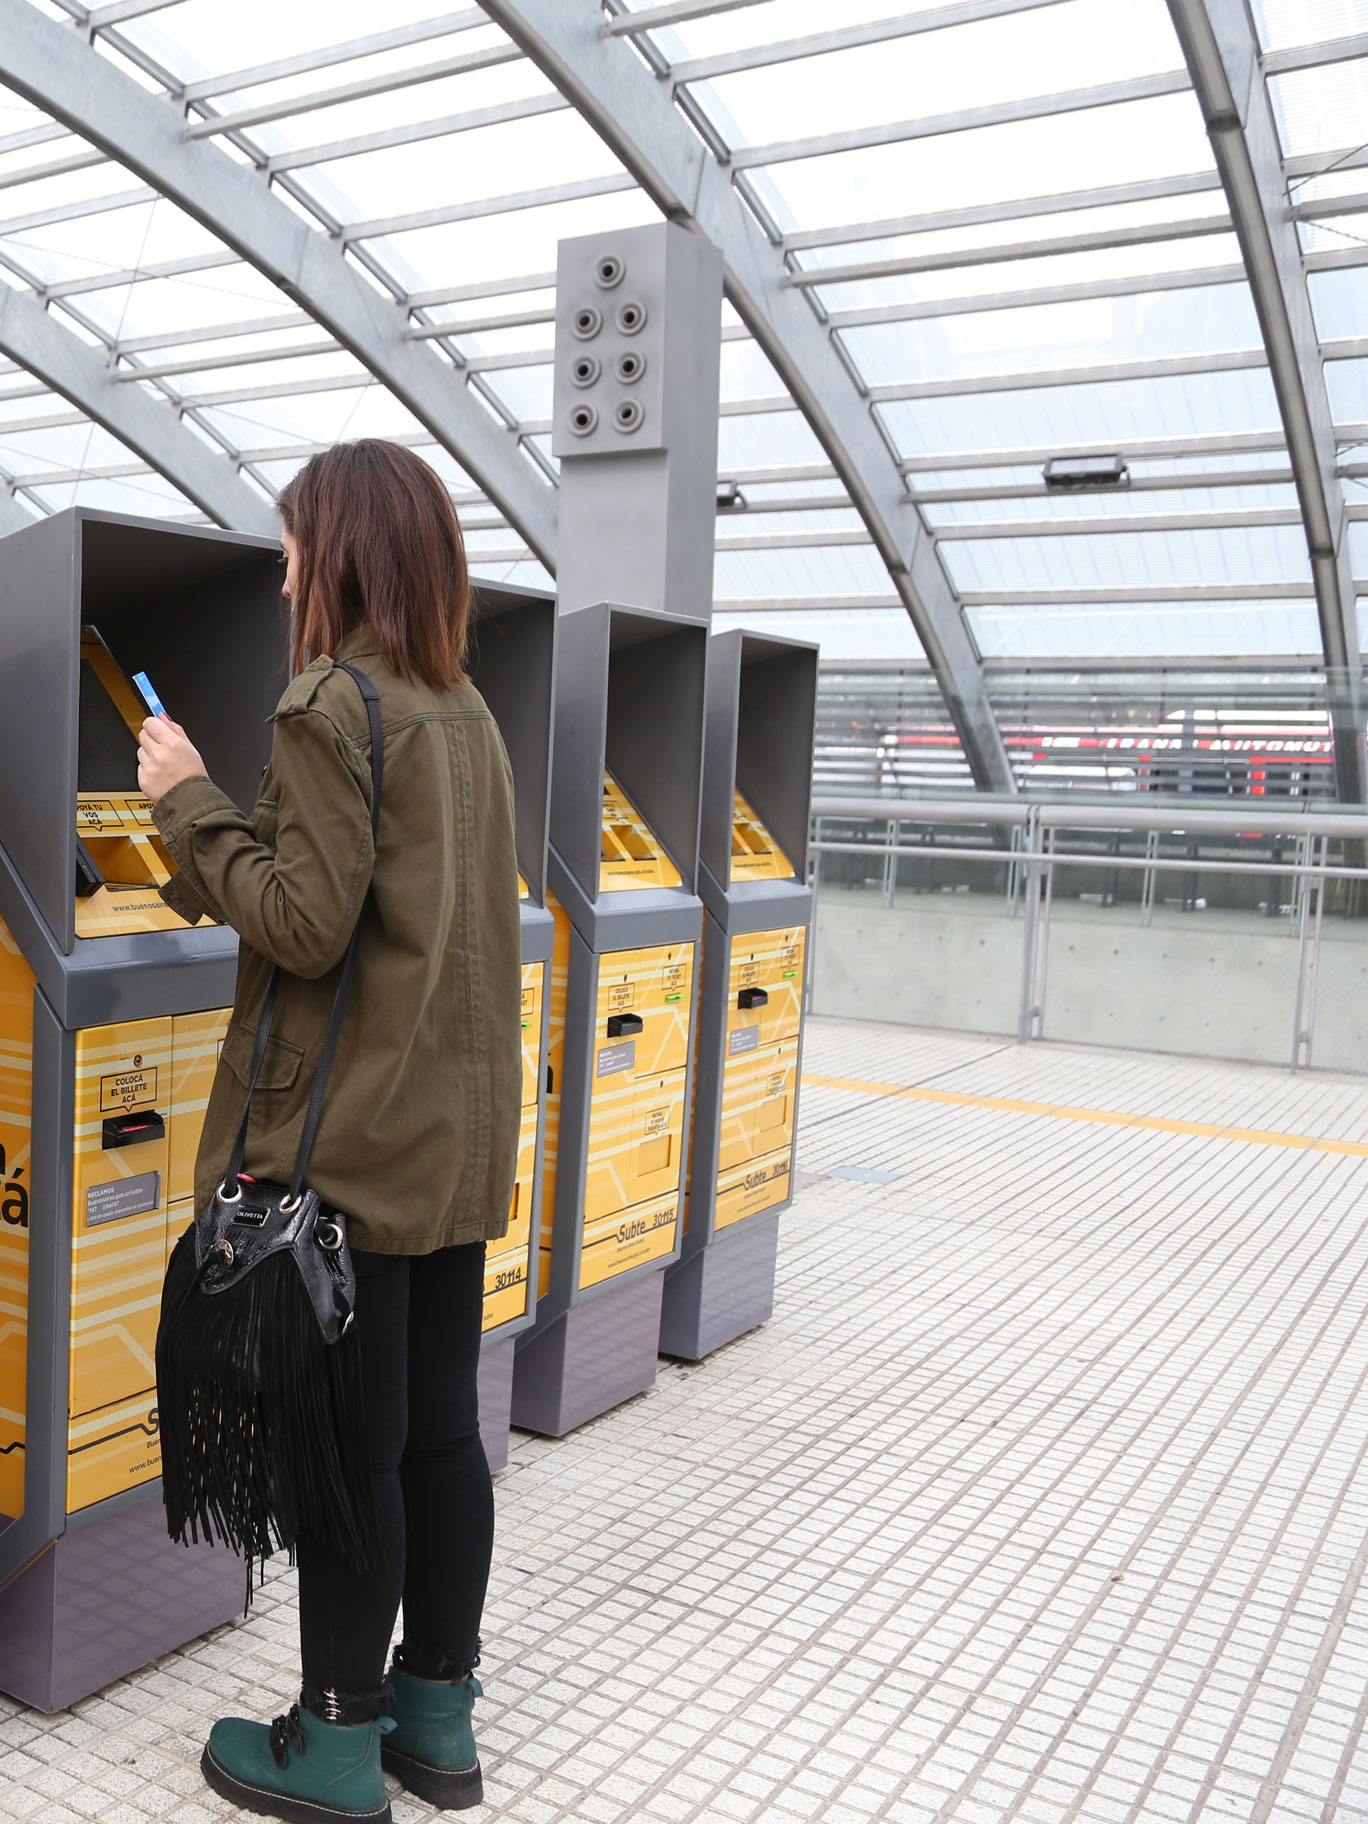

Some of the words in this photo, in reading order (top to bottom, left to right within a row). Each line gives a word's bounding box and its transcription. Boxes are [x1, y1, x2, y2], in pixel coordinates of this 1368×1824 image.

[116, 1073, 143, 1086] COLOCÁ
[111, 1088, 119, 1097] EL
[121, 1083, 147, 1094] BILLETE
[122, 1094, 136, 1103] ACÁ
[745, 1170, 767, 1191] Subte
[88, 1187, 114, 1198] RECLAMOS
[236, 1211, 263, 1219] OLIVETTA
[619, 1220, 646, 1243] Subte
[653, 1208, 674, 1227] 30115
[495, 1266, 522, 1290] 30114
